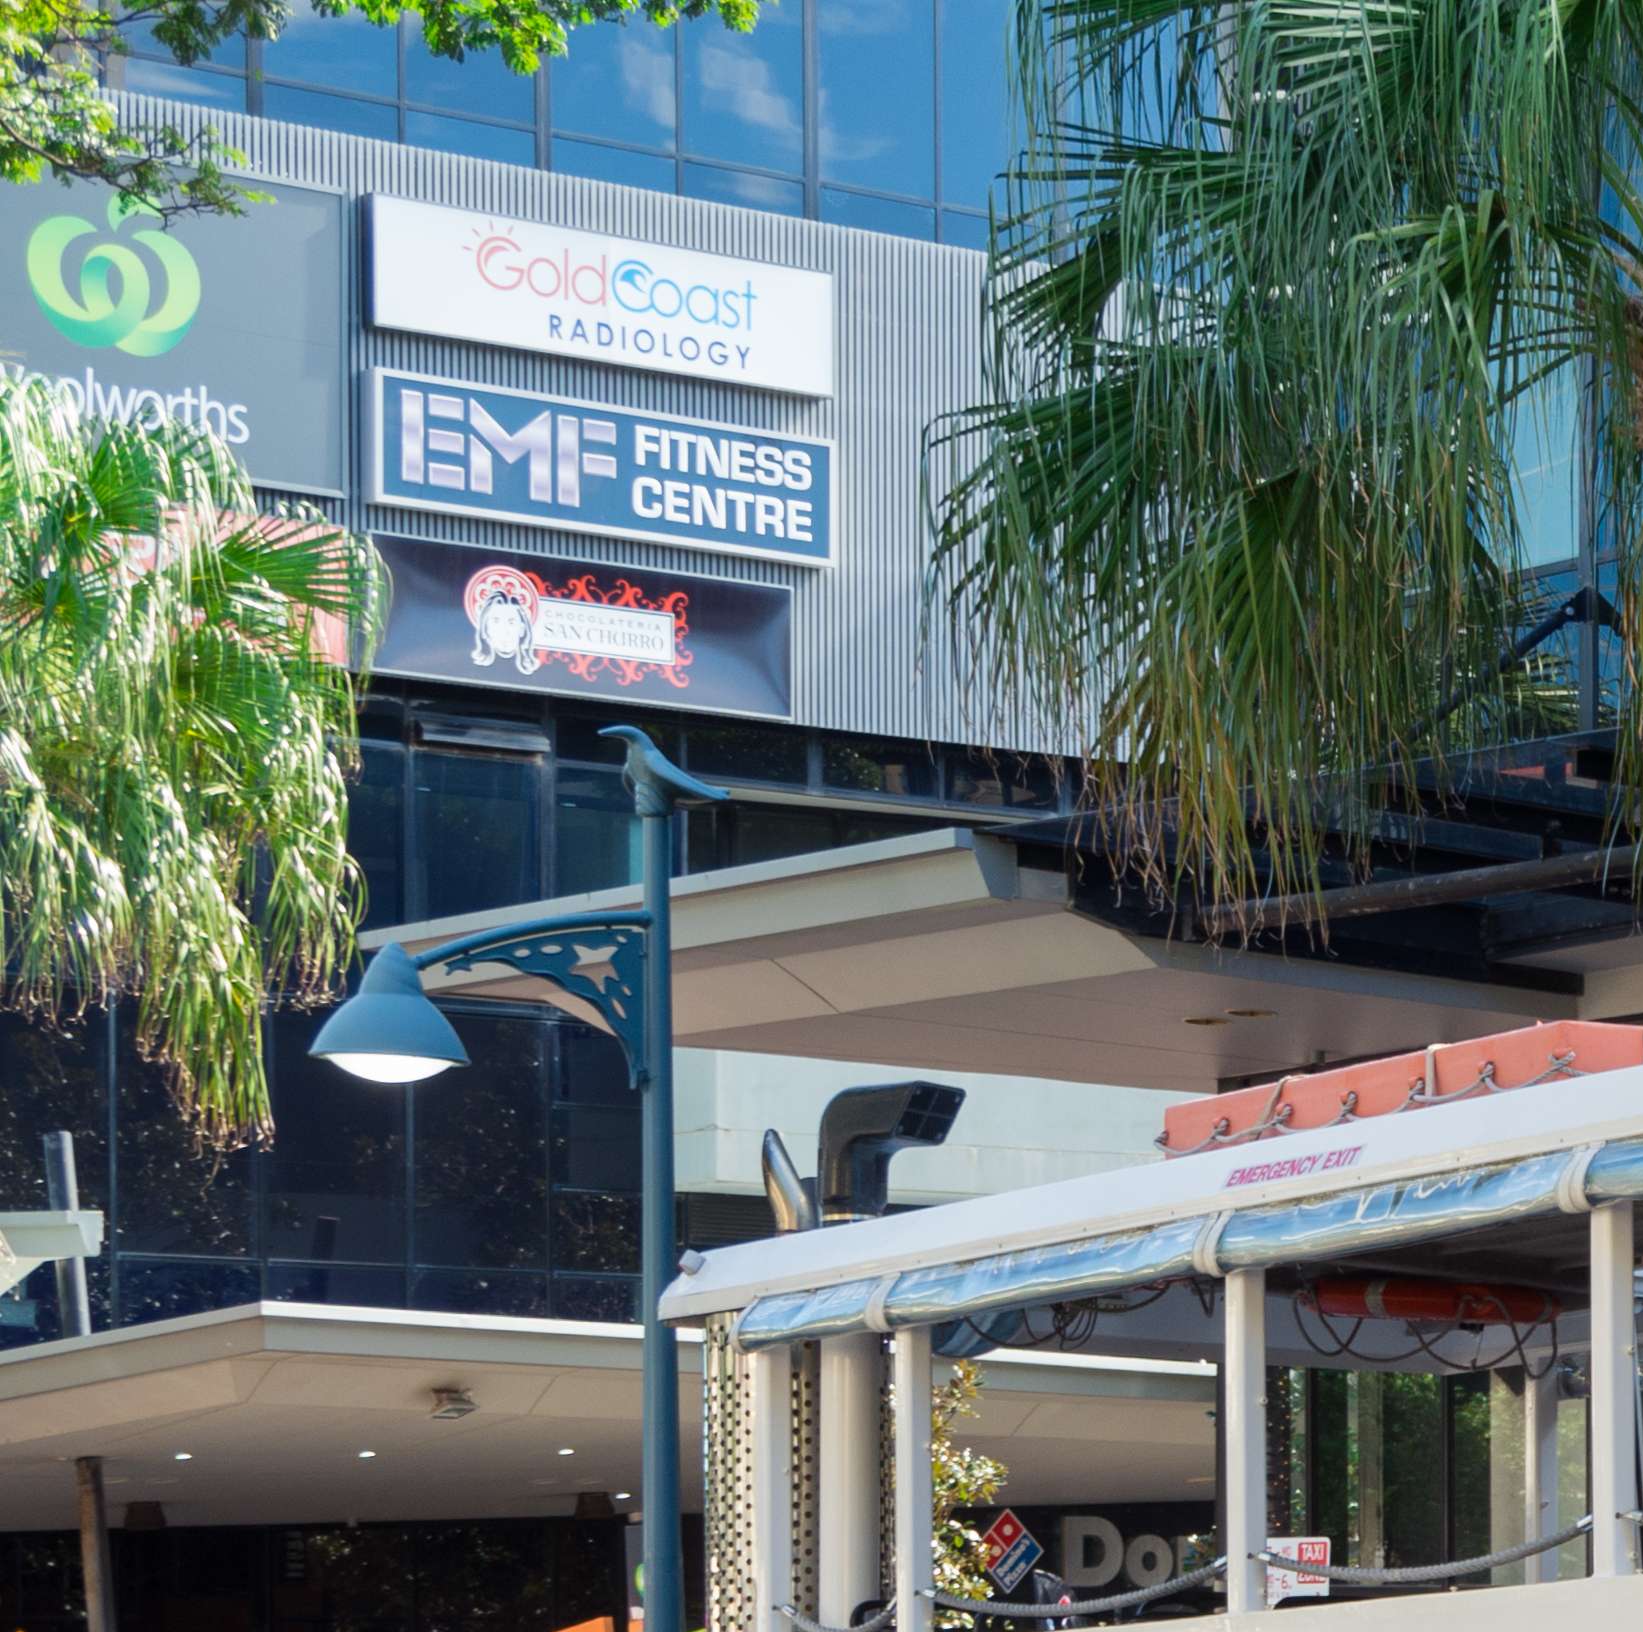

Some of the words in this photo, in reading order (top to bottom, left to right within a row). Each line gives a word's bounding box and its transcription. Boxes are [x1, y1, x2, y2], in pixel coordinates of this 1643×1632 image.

[548, 313, 751, 370] RADIOLOGY
[401, 388, 618, 509] EMF
[633, 423, 814, 491] FITNESS
[630, 475, 814, 543] CENTRE
[543, 623, 583, 642] SAN
[586, 625, 665, 652] CHURRO
[544, 609, 662, 631] CHOCOLATERIA
[1225, 1153, 1323, 1187] EMERGENCY
[1322, 1145, 1362, 1171] EXIT
[1300, 1542, 1326, 1561] TAXI
